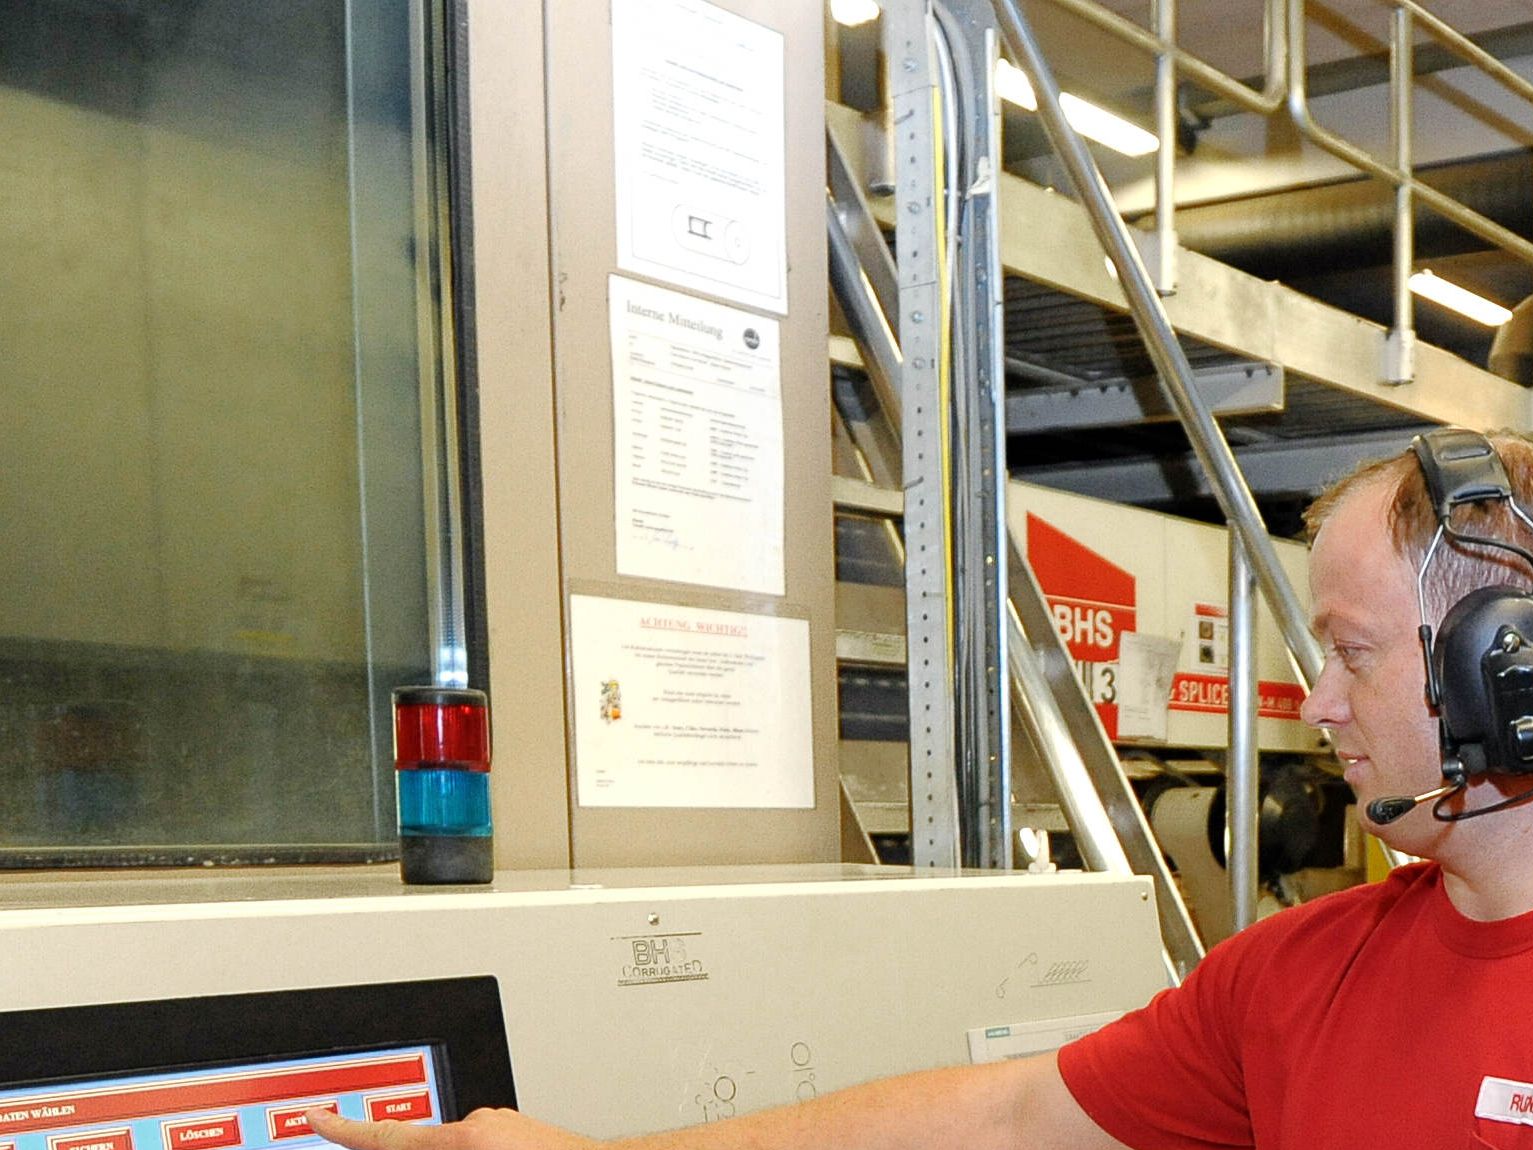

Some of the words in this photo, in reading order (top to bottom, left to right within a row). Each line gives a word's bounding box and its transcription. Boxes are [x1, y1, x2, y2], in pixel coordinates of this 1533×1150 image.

[626, 300, 665, 322] Interne
[668, 311, 723, 341] Mitteilung
[1054, 604, 1114, 648] BHS
[1101, 667, 1116, 703] 3
[31, 1104, 76, 1119] WÄHLEN
[386, 1102, 412, 1114] START
[180, 1127, 224, 1142] LÖSCHEN
